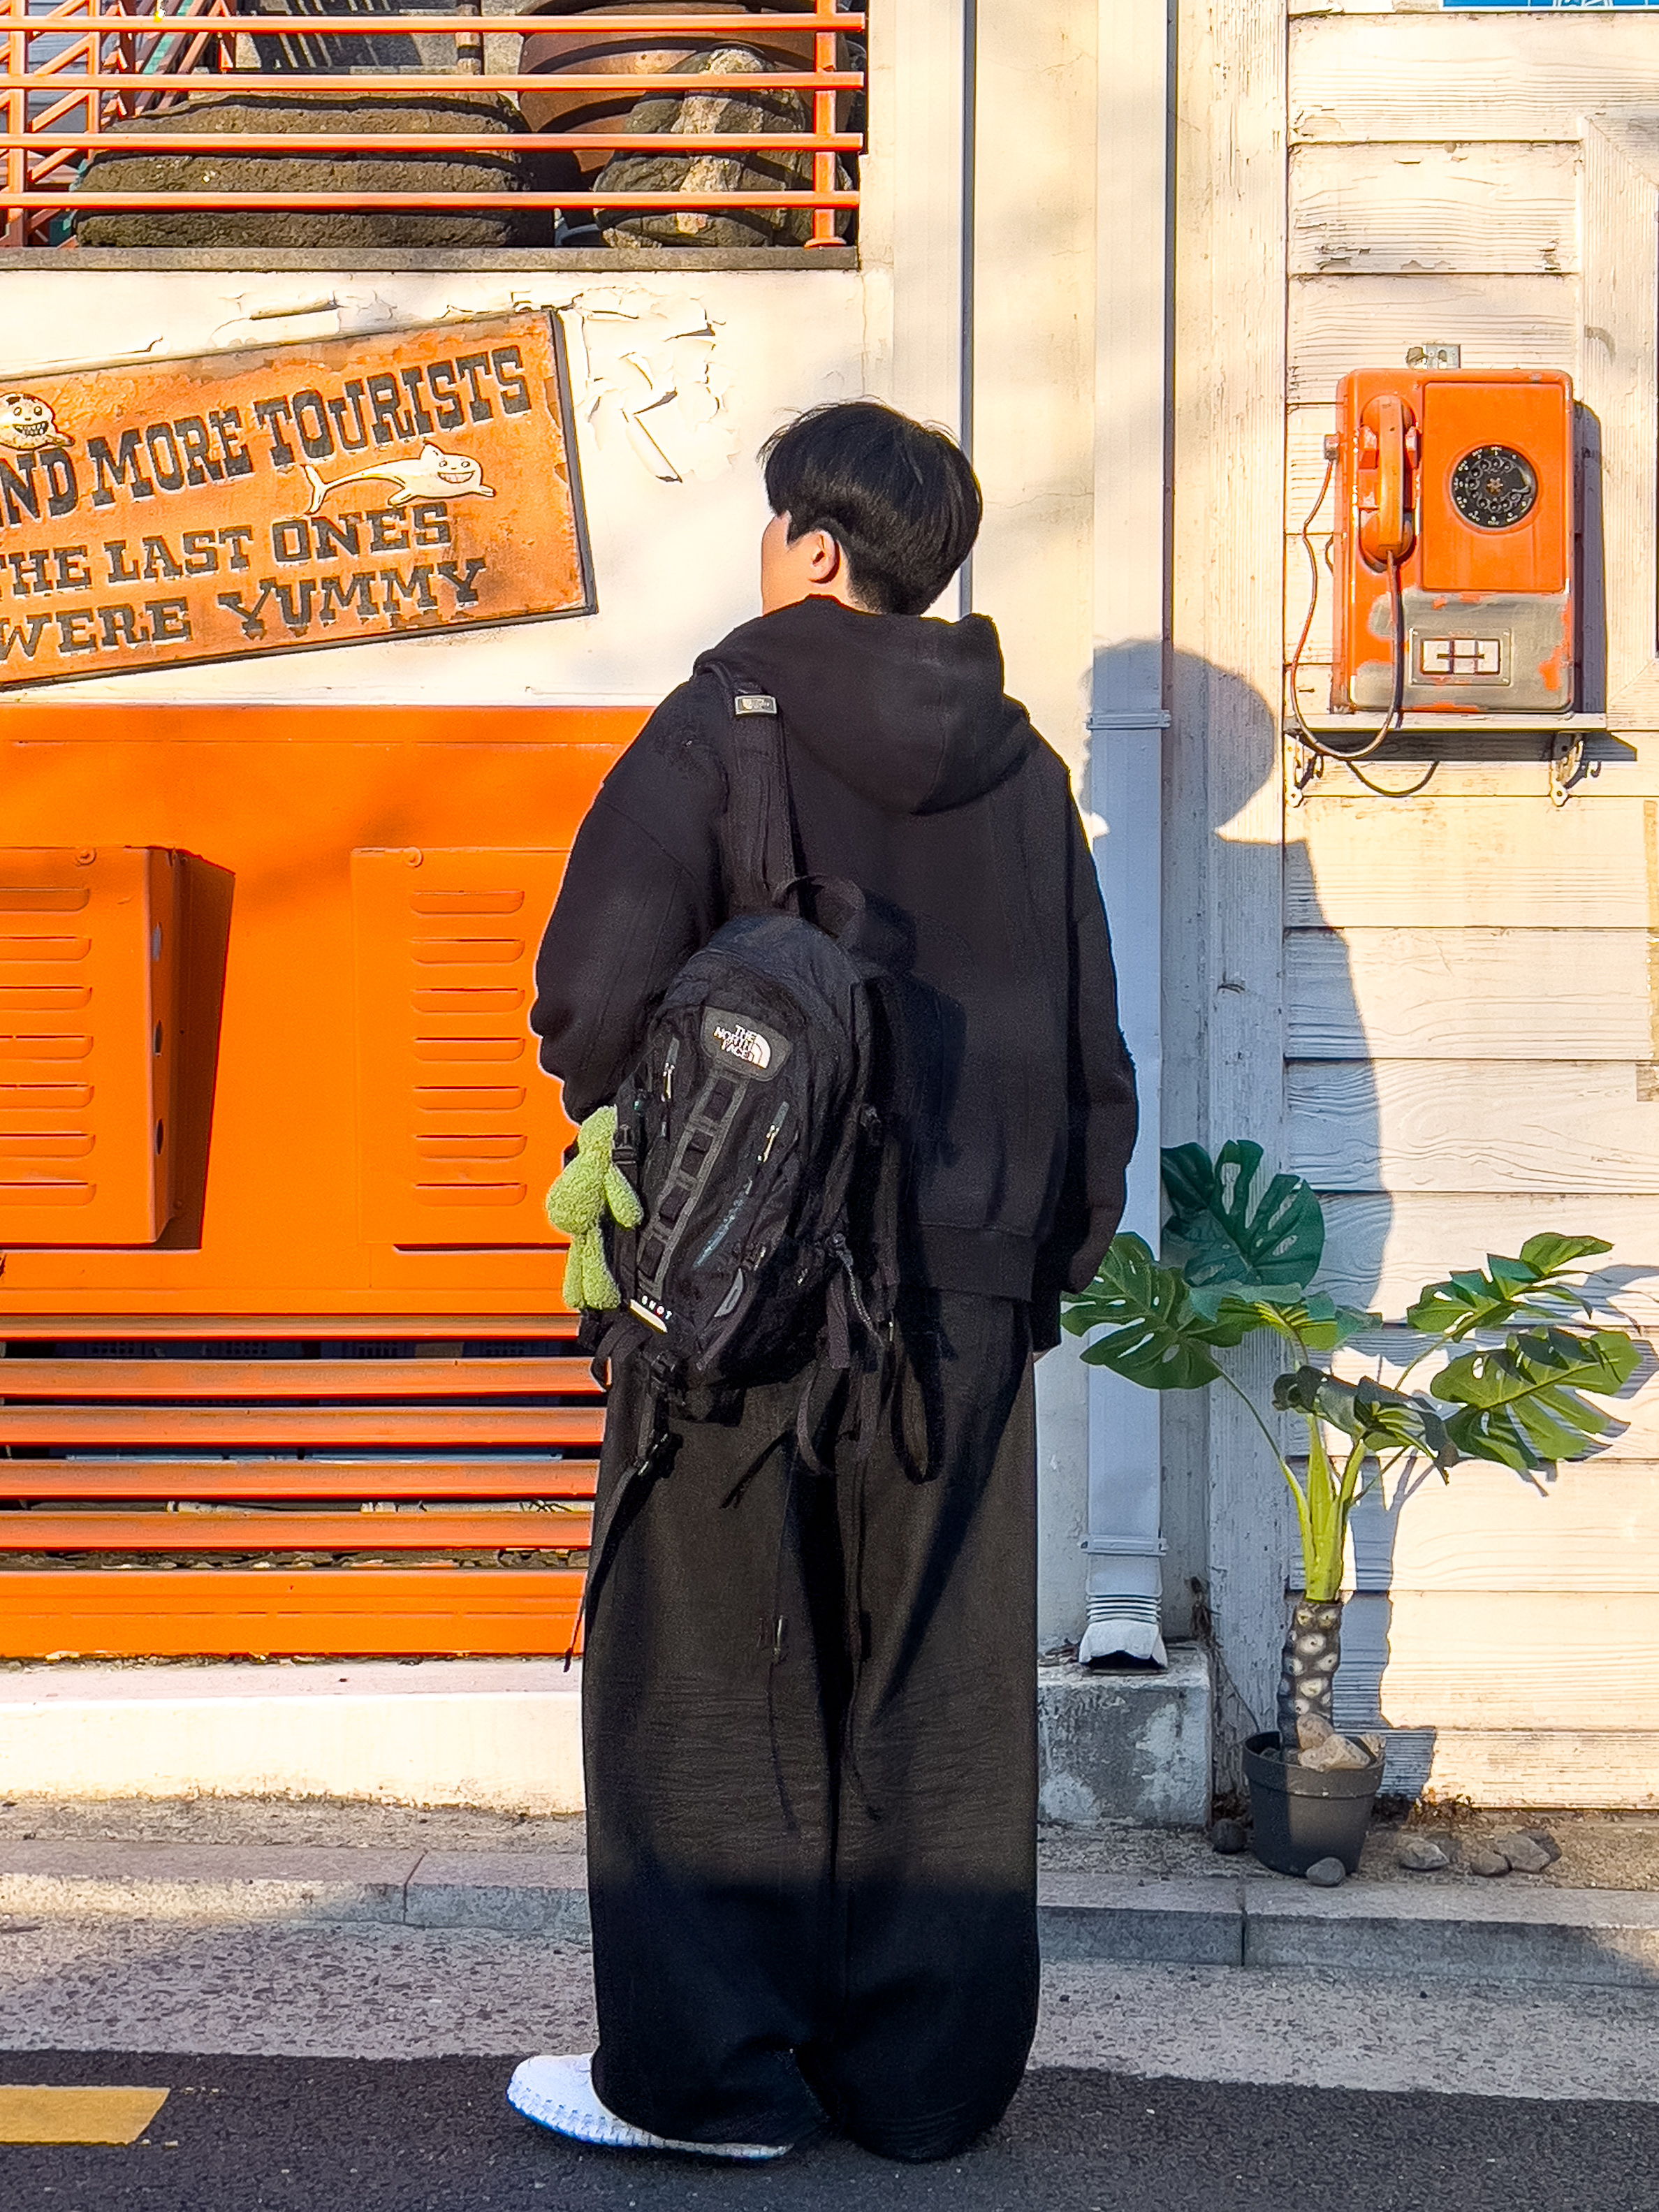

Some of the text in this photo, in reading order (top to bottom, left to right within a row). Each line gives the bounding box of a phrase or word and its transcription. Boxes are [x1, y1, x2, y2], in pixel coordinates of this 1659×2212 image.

[0, 344, 532, 525] ND MORE TOURISTS
[0, 501, 452, 597] HE LAST ONES
[0, 557, 488, 660] WERE YUMMY
[712, 1027, 753, 1052] NORTH
[721, 1039, 751, 1060] FACE
[735, 1024, 757, 1041] THE
